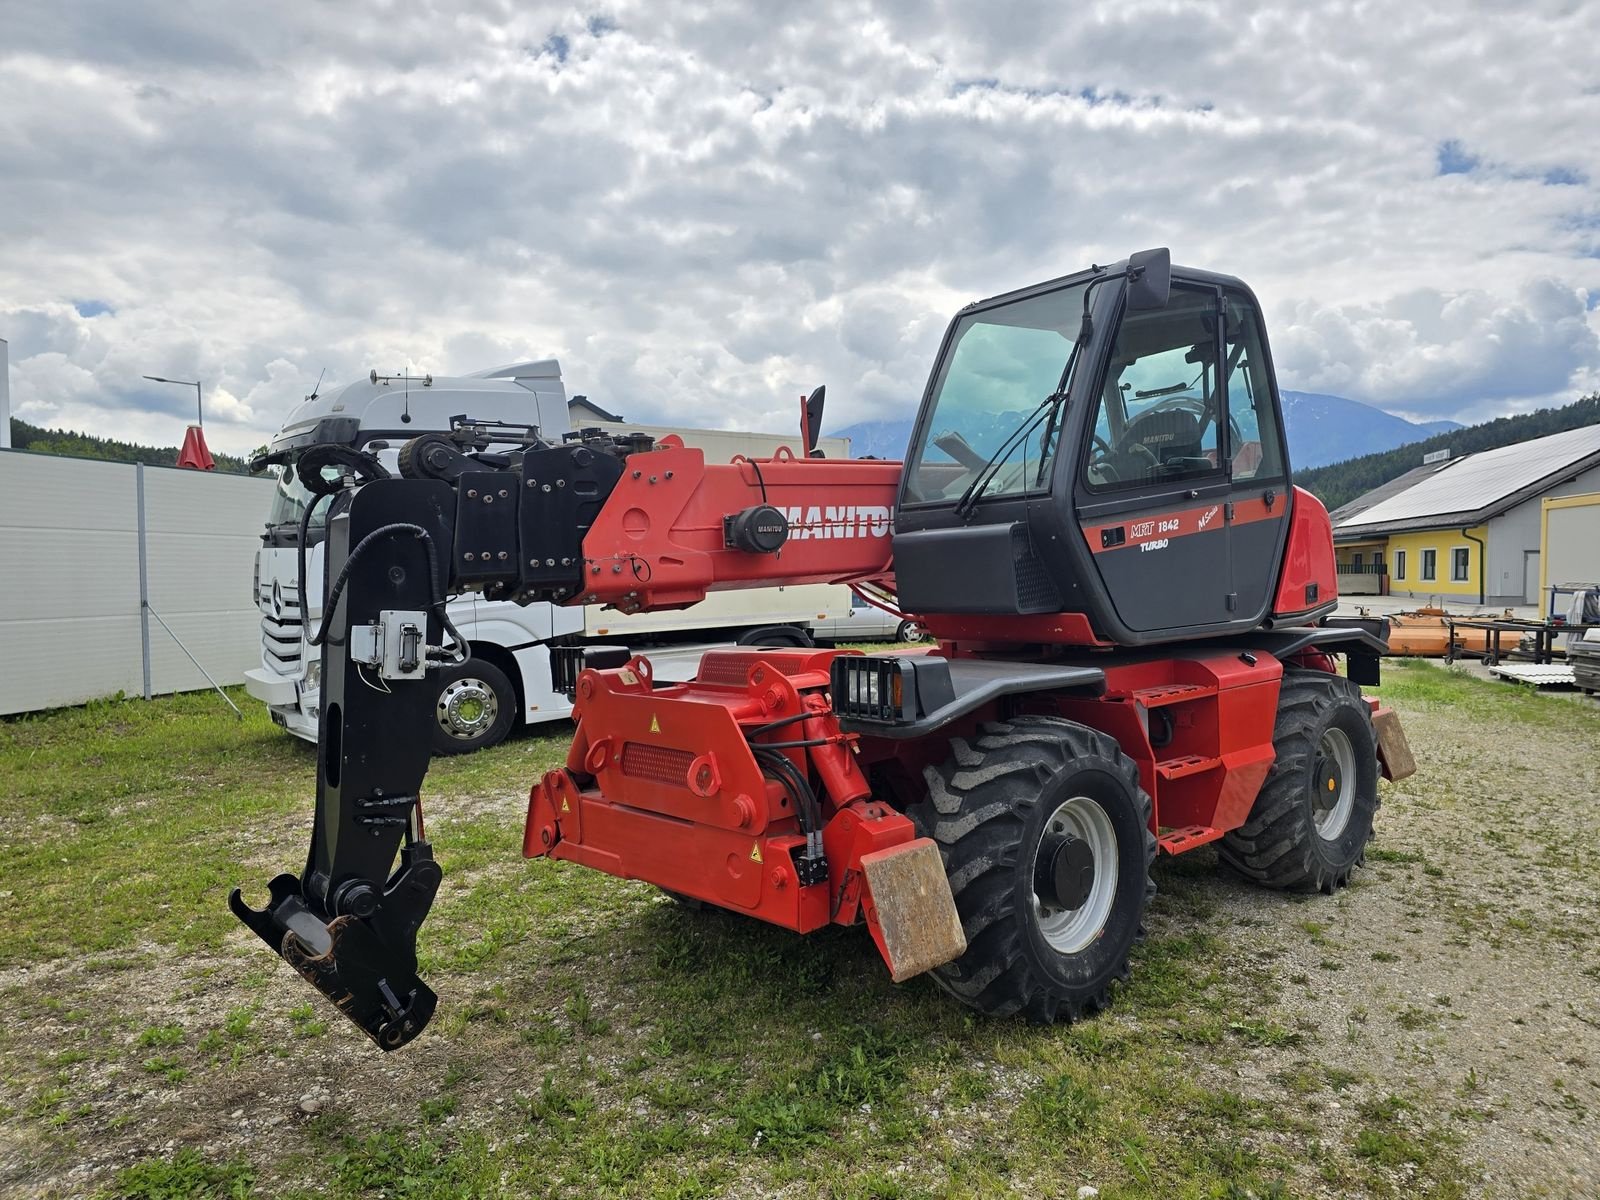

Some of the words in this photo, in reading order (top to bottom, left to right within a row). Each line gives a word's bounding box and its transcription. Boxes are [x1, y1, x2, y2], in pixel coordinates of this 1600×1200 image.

[1143, 433, 1174, 444] MANITOU
[774, 506, 895, 539] MANITO
[1130, 521, 1155, 539] MRT
[1158, 519, 1179, 533] 1842
[1140, 538, 1169, 553] TURBO
